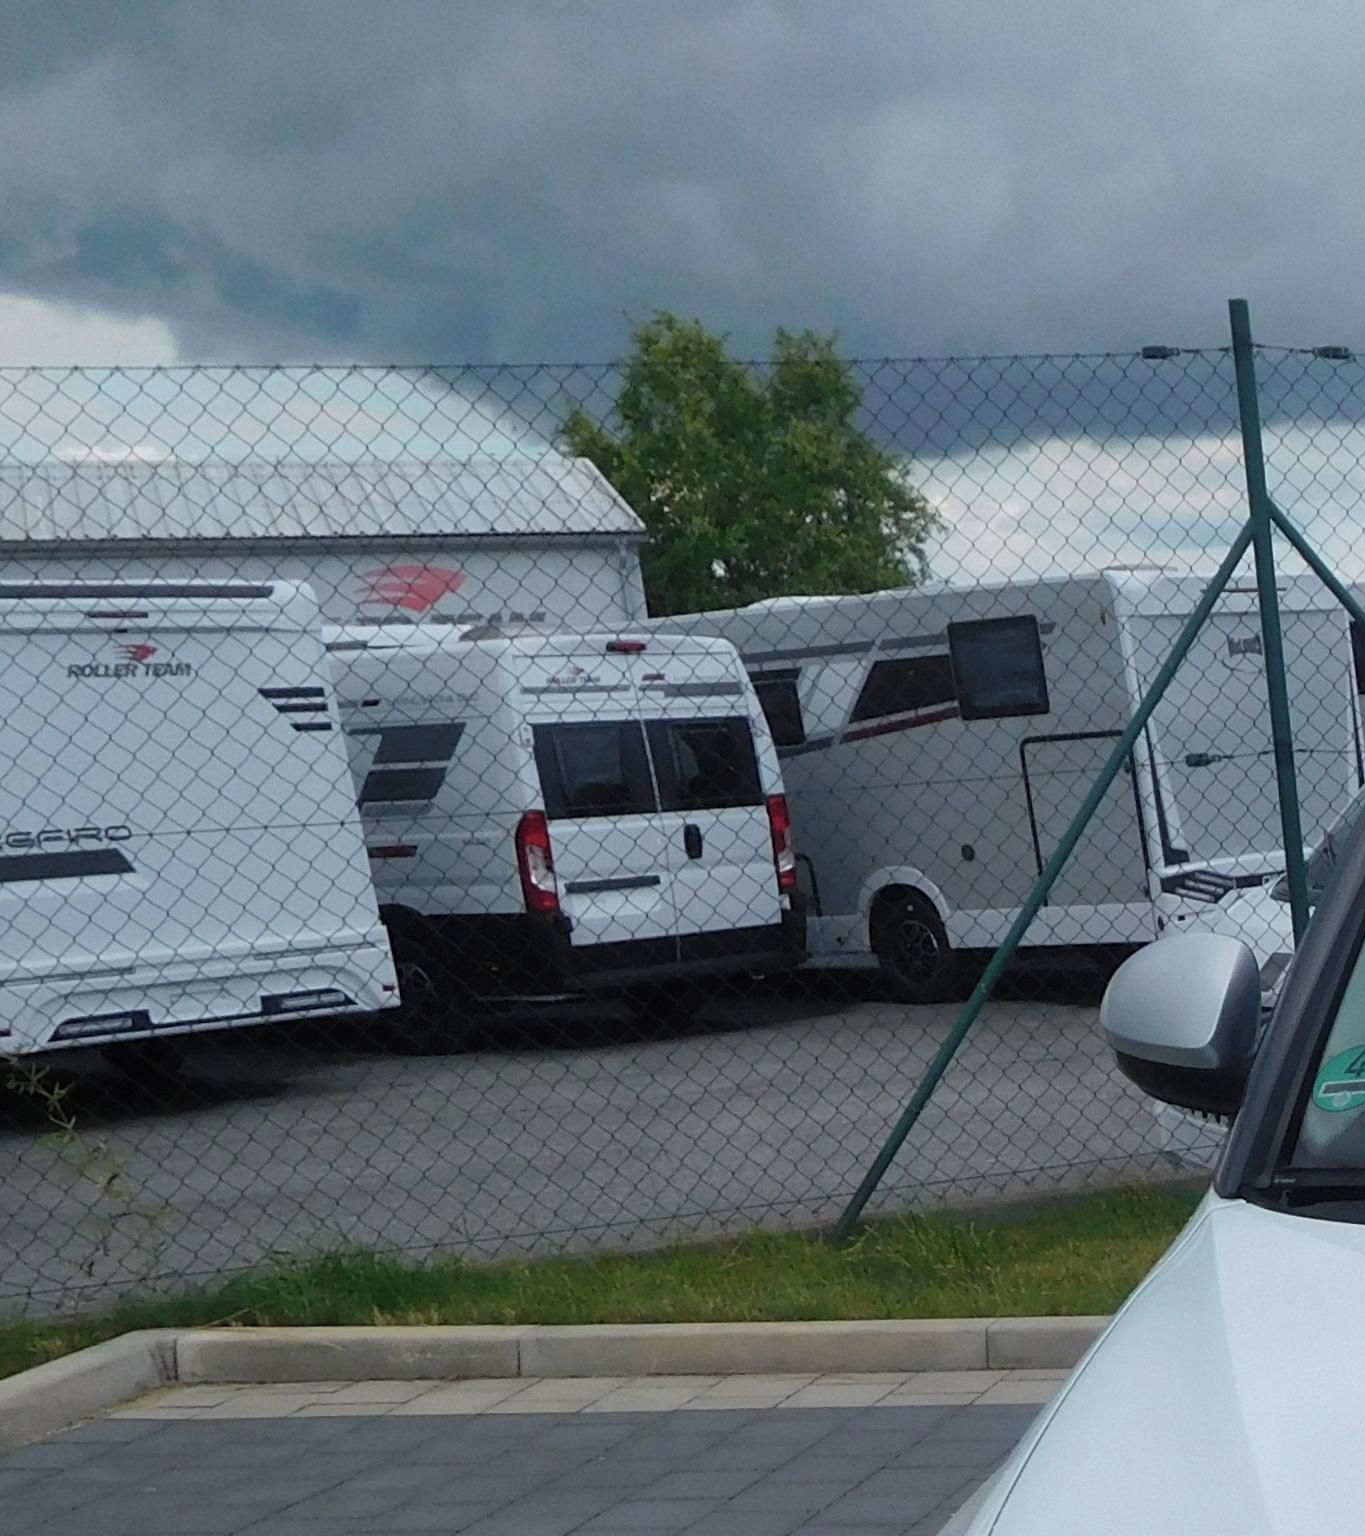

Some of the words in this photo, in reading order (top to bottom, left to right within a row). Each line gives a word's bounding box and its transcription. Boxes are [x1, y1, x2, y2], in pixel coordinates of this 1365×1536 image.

[67, 663, 138, 678] ROLLER
[145, 662, 192, 677] TEAM
[0, 825, 132, 848] EFIRO
